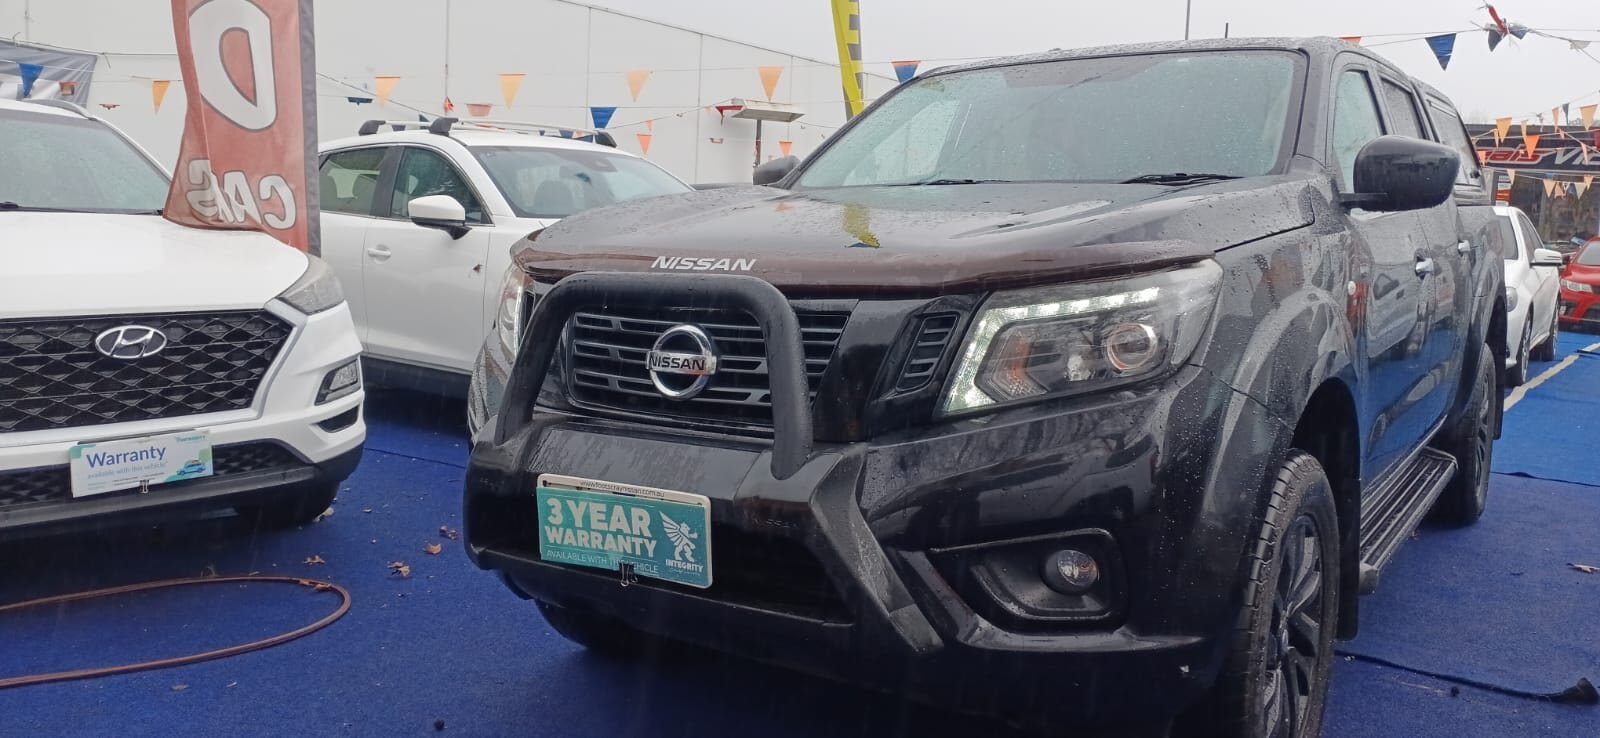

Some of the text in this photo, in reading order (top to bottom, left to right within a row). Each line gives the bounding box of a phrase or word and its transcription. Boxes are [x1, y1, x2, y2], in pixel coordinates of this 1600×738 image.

[651, 255, 757, 271] NISSAN
[649, 354, 706, 371] NISSAN
[86, 446, 166, 468] Warranty
[546, 498, 653, 537] 3 YEAR
[544, 525, 657, 558] WARRANTY
[546, 550, 586, 562] AVAILABLE
[588, 554, 608, 566] WITH
[628, 560, 659, 574] EHICLE
[665, 559, 703, 573] INTEGRITY
